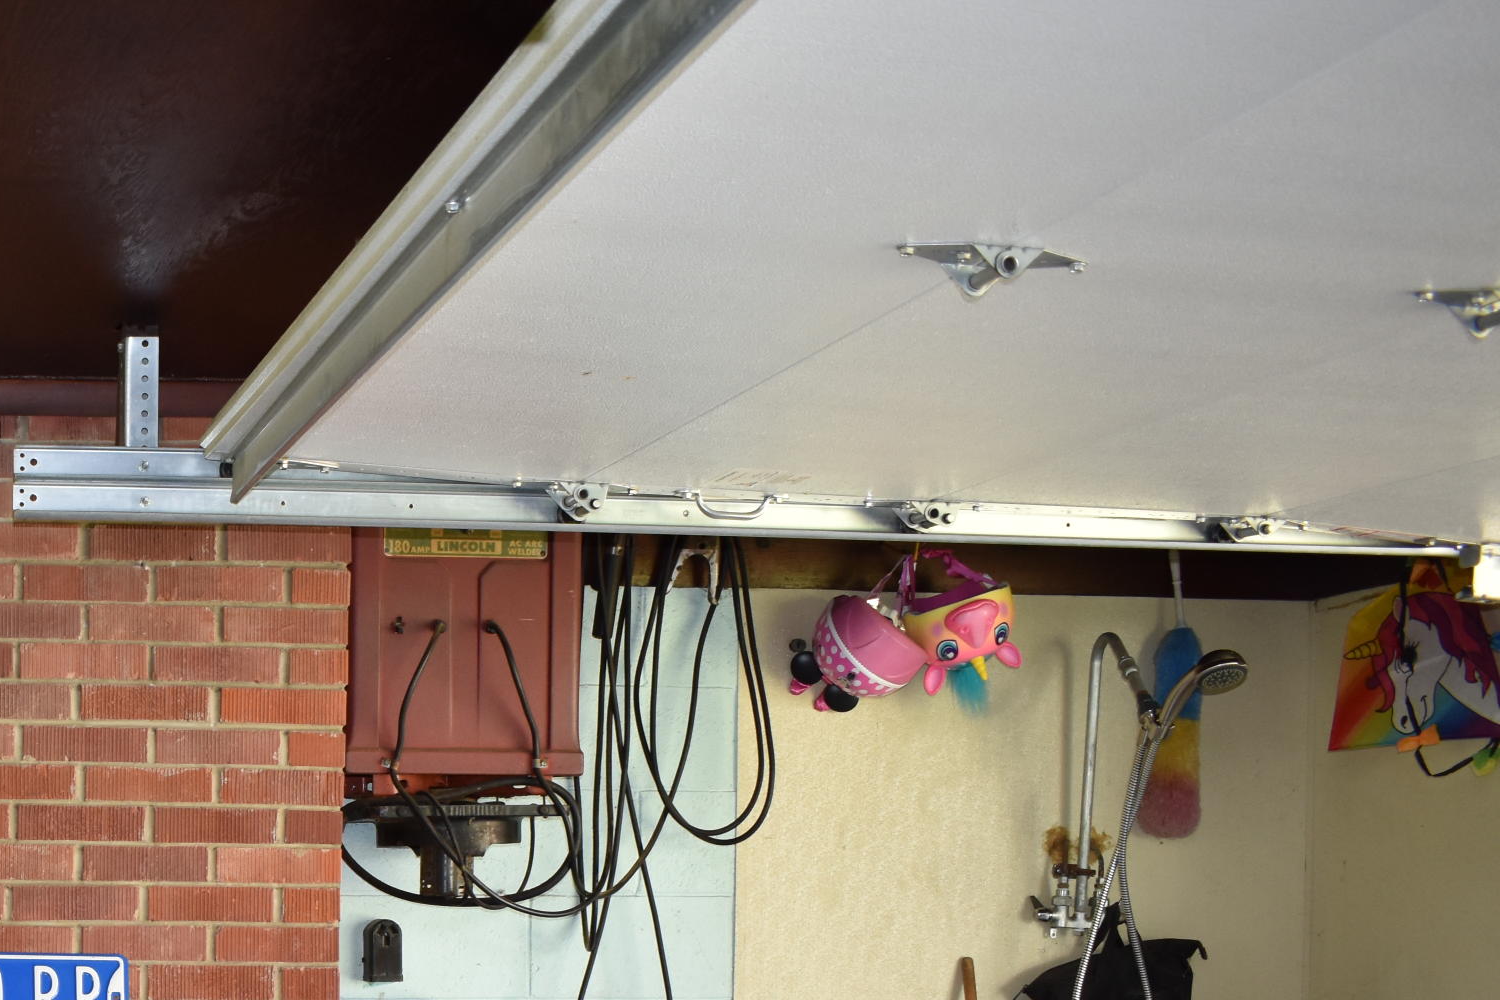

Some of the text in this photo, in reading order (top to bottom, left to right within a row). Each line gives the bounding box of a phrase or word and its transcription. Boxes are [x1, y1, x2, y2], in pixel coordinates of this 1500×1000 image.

[388, 539, 431, 554] 180 AMP
[436, 541, 496, 552] LINCOLN
[508, 547, 542, 556] WELDER
